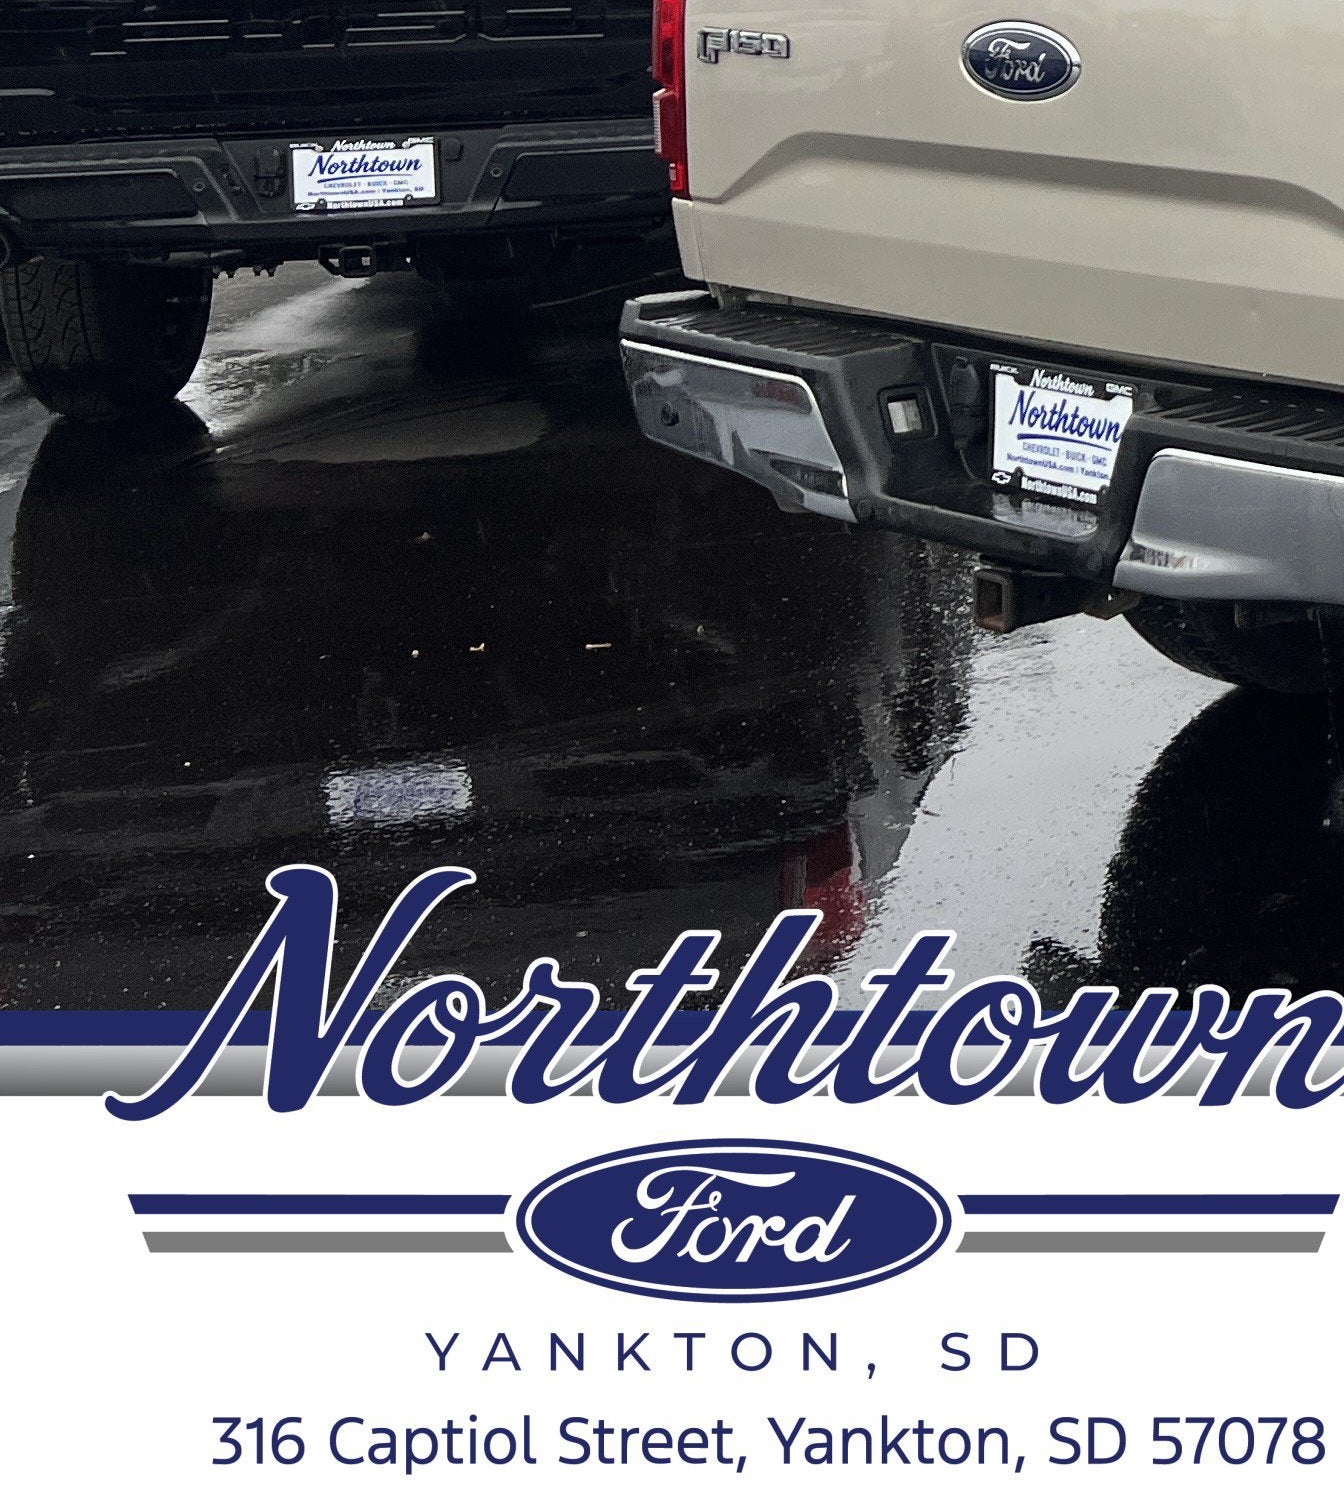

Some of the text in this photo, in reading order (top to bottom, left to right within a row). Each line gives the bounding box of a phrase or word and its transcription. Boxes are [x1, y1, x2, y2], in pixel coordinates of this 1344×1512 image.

[985, 37, 1047, 83] Ford
[331, 140, 396, 153] Northtown
[308, 154, 422, 177] Northtown
[1029, 368, 1095, 397] Northtown
[1008, 389, 1122, 443] Northtown
